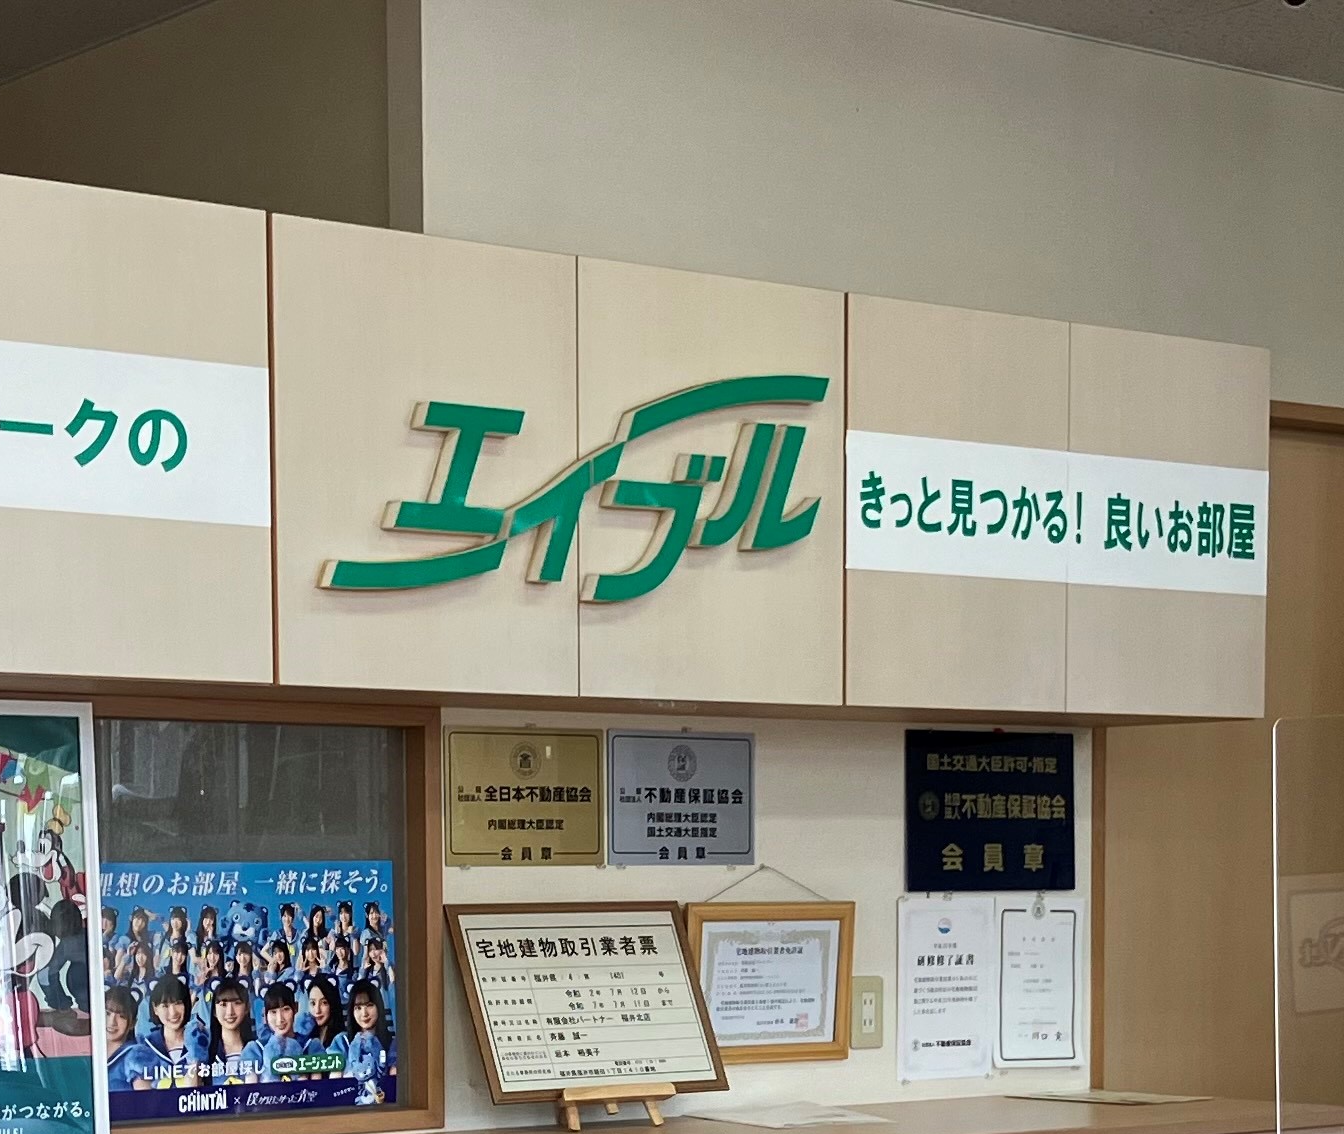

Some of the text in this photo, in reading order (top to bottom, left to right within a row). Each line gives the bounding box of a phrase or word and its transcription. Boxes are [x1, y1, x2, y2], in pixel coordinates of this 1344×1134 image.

[320, 375, 830, 602] エイブル
[859, 469, 1257, 561] きっと見つかる！ 良いお部屋
[484, 785, 592, 804] 全日本不動産協会
[644, 787, 743, 805] 不動産保証協会
[961, 793, 1066, 820] 不動産保証協会
[500, 846, 553, 861] 会員章
[658, 846, 706, 860] 会員章
[942, 843, 1045, 872] 会員章
[475, 935, 659, 959] 宅地建物取引業者票
[546, 1015, 614, 1026] 有限会社パートナー
[143, 1060, 266, 1080] LINEでお部屋探し
[298, 1056, 342, 1072] エージェント
[178, 1088, 228, 1113] CHINTAI
